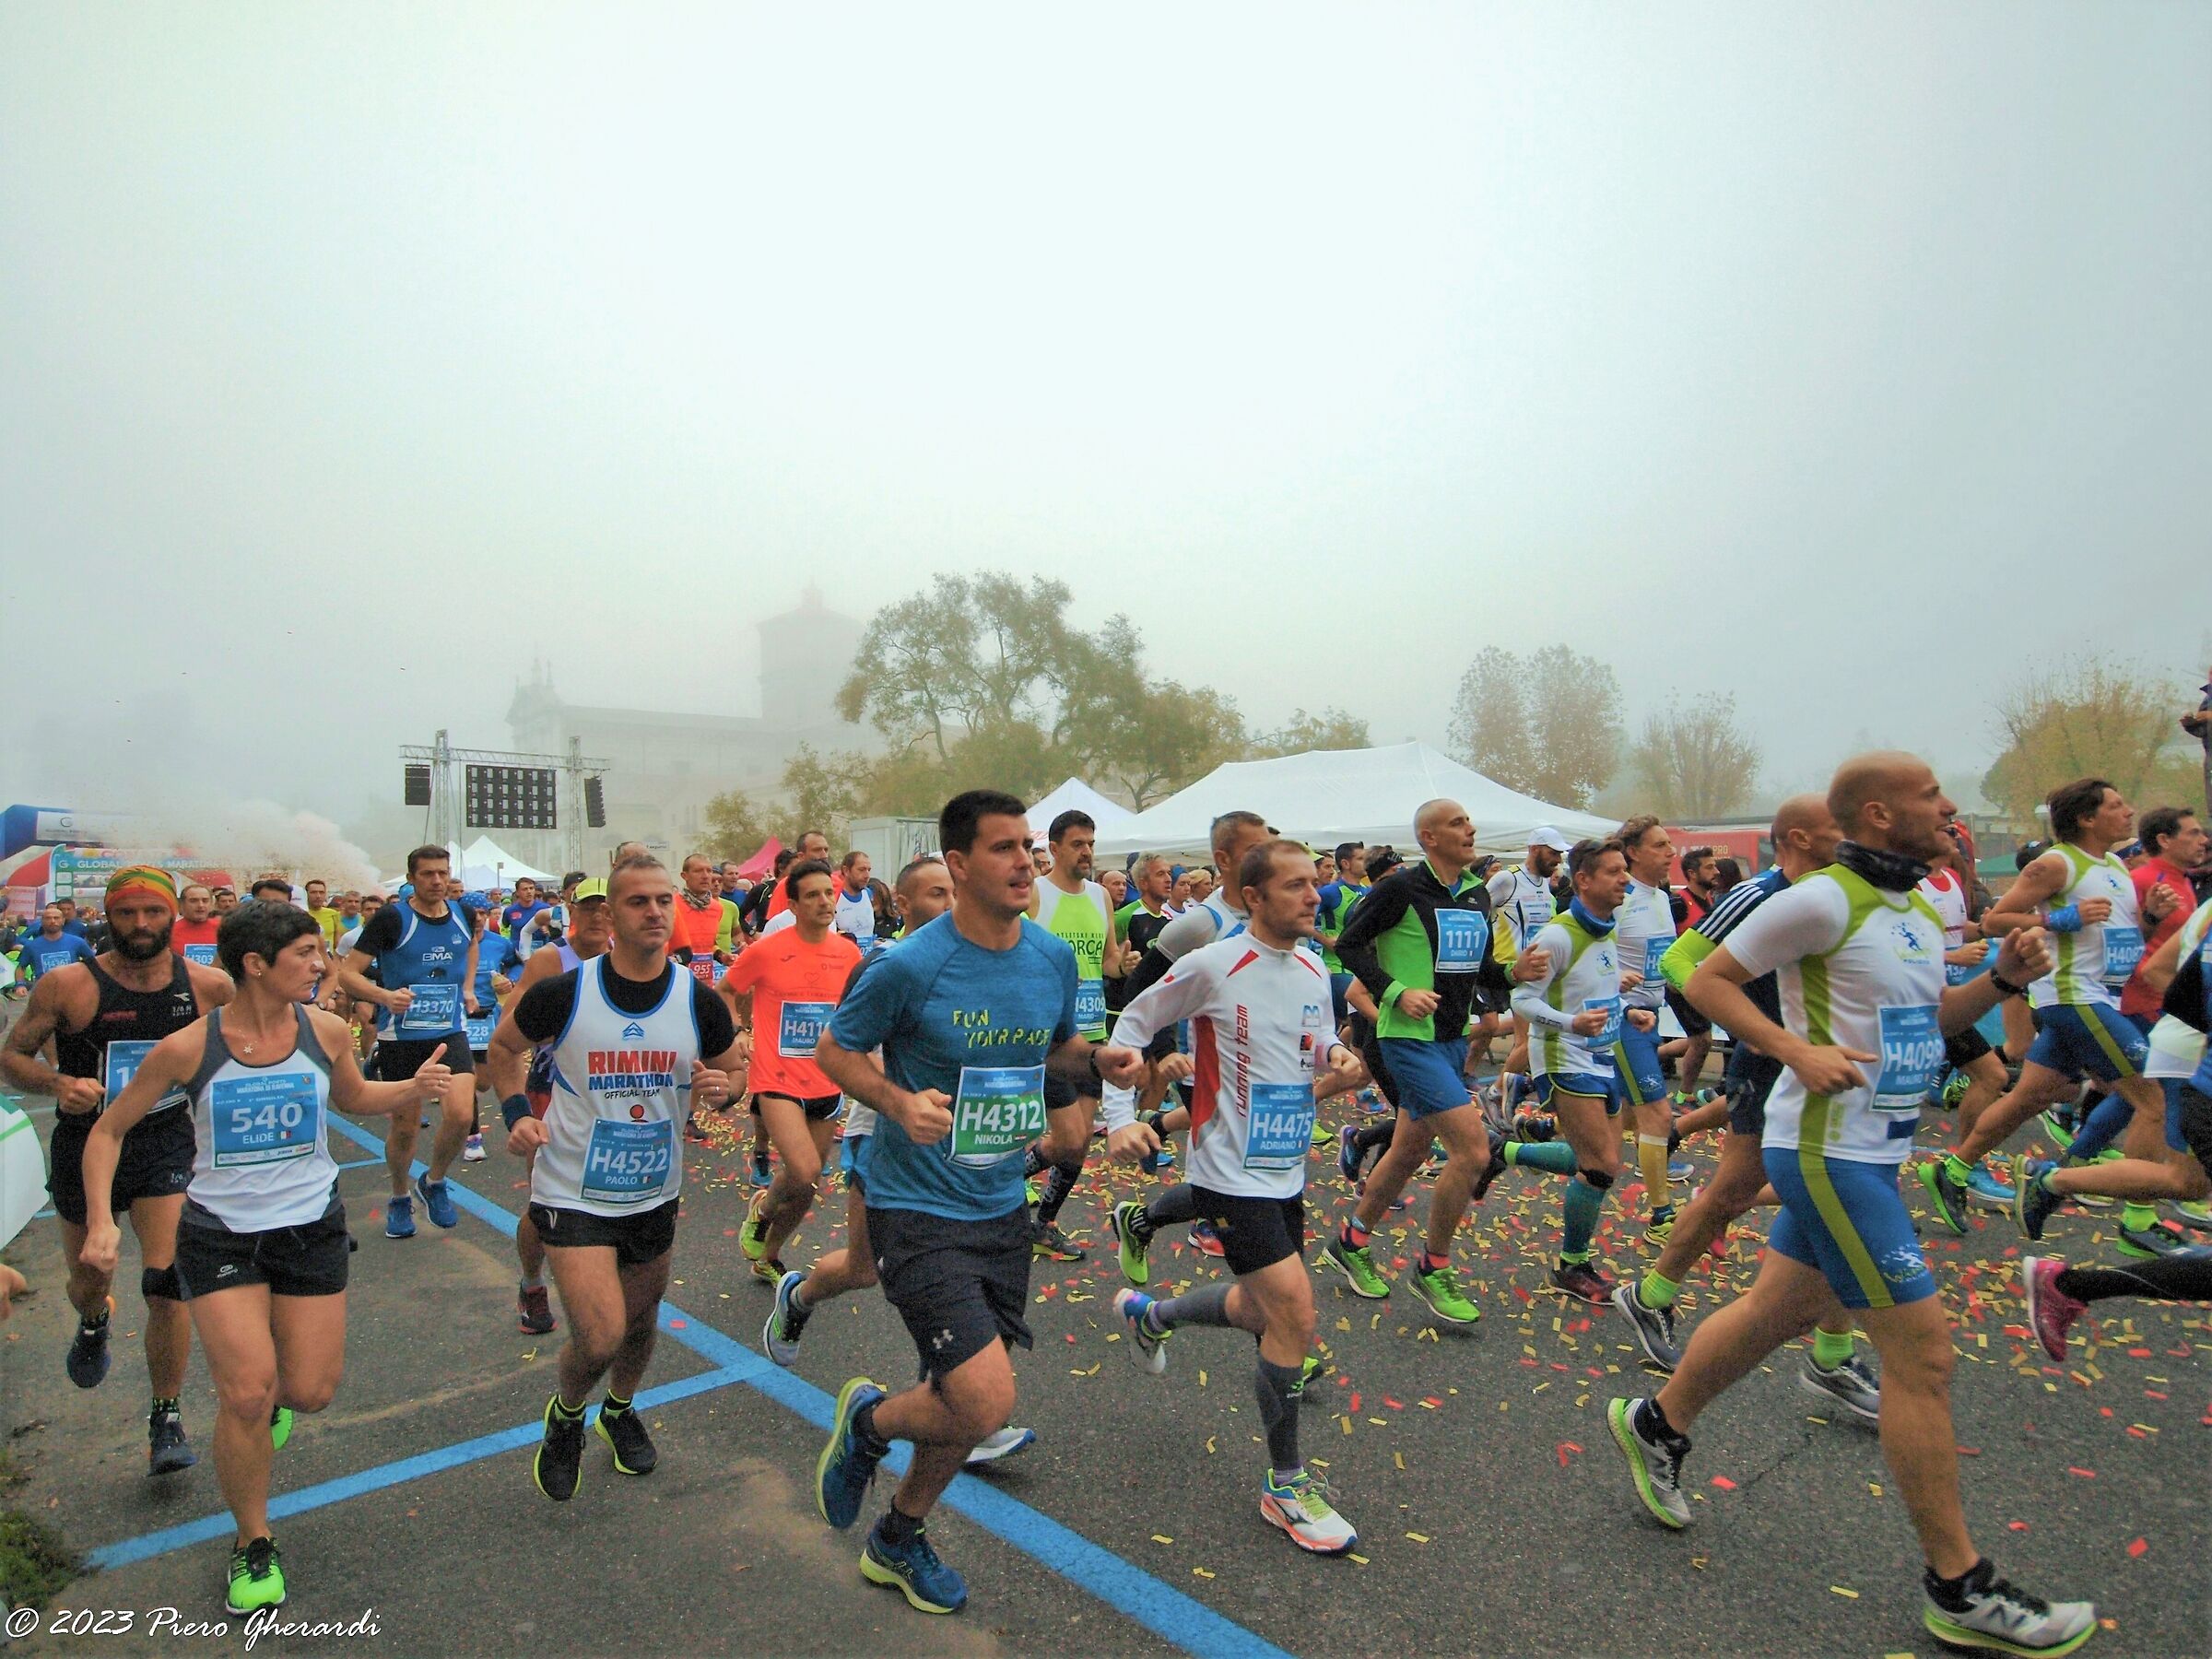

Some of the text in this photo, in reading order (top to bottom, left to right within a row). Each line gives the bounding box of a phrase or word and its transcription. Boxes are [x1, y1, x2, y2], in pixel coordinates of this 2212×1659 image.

[1446, 930, 1480, 948] 1111
[694, 964, 711, 974] 955
[588, 1050, 677, 1075] RIMINI
[1234, 1004, 1251, 1118] running team
[588, 1073, 674, 1091] MARATHON
[604, 1088, 641, 1100] OFFICIAL
[230, 1101, 303, 1134] 540
[960, 1100, 1042, 1132] H4312
[1252, 1112, 1313, 1138] H4475
[242, 1132, 275, 1145] ELIDE
[974, 1134, 1014, 1145] NIKOLA
[1260, 1140, 1297, 1150] ADRIANO
[590, 1147, 667, 1175] H4522
[605, 1175, 638, 1185] PAOLO
